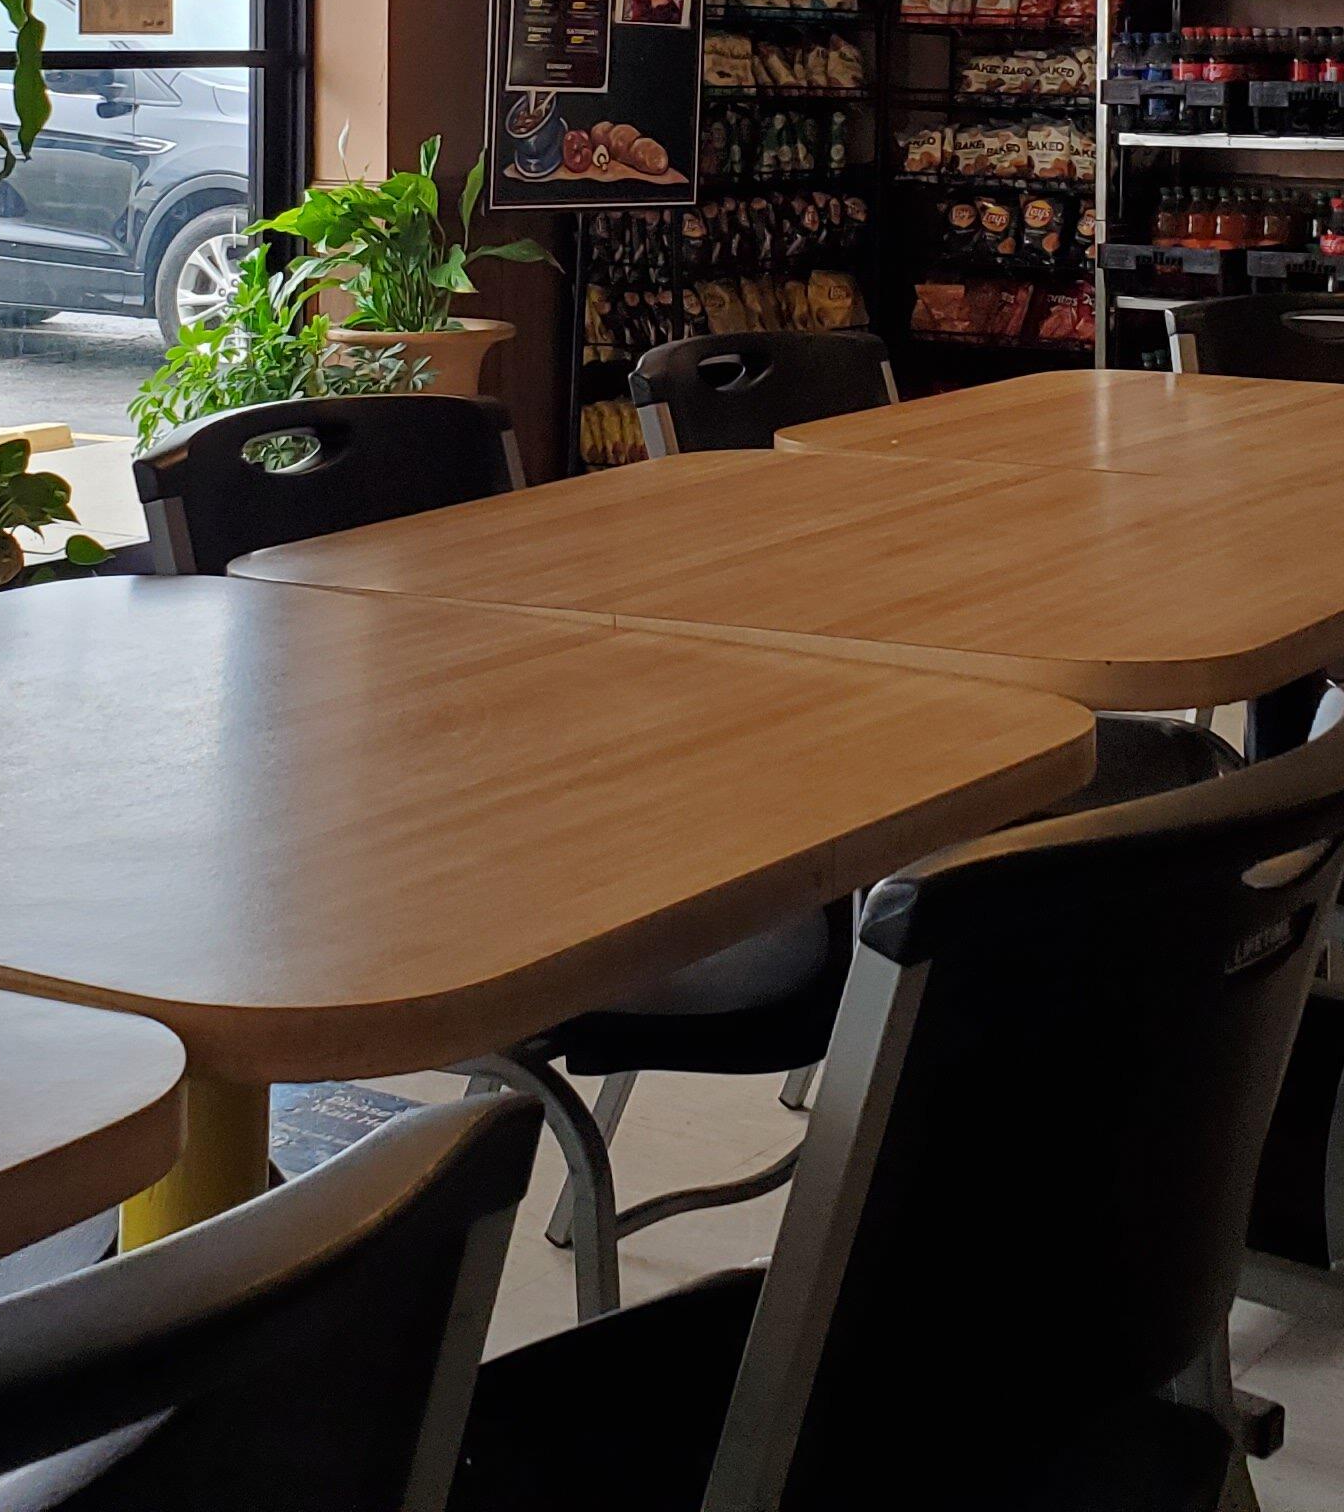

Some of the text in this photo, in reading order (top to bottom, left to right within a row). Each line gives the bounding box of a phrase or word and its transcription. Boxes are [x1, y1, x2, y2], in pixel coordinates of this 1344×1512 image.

[954, 140, 985, 151] BAKE
[1027, 140, 1065, 152] BAKED
[1069, 145, 1096, 159] BAKE
